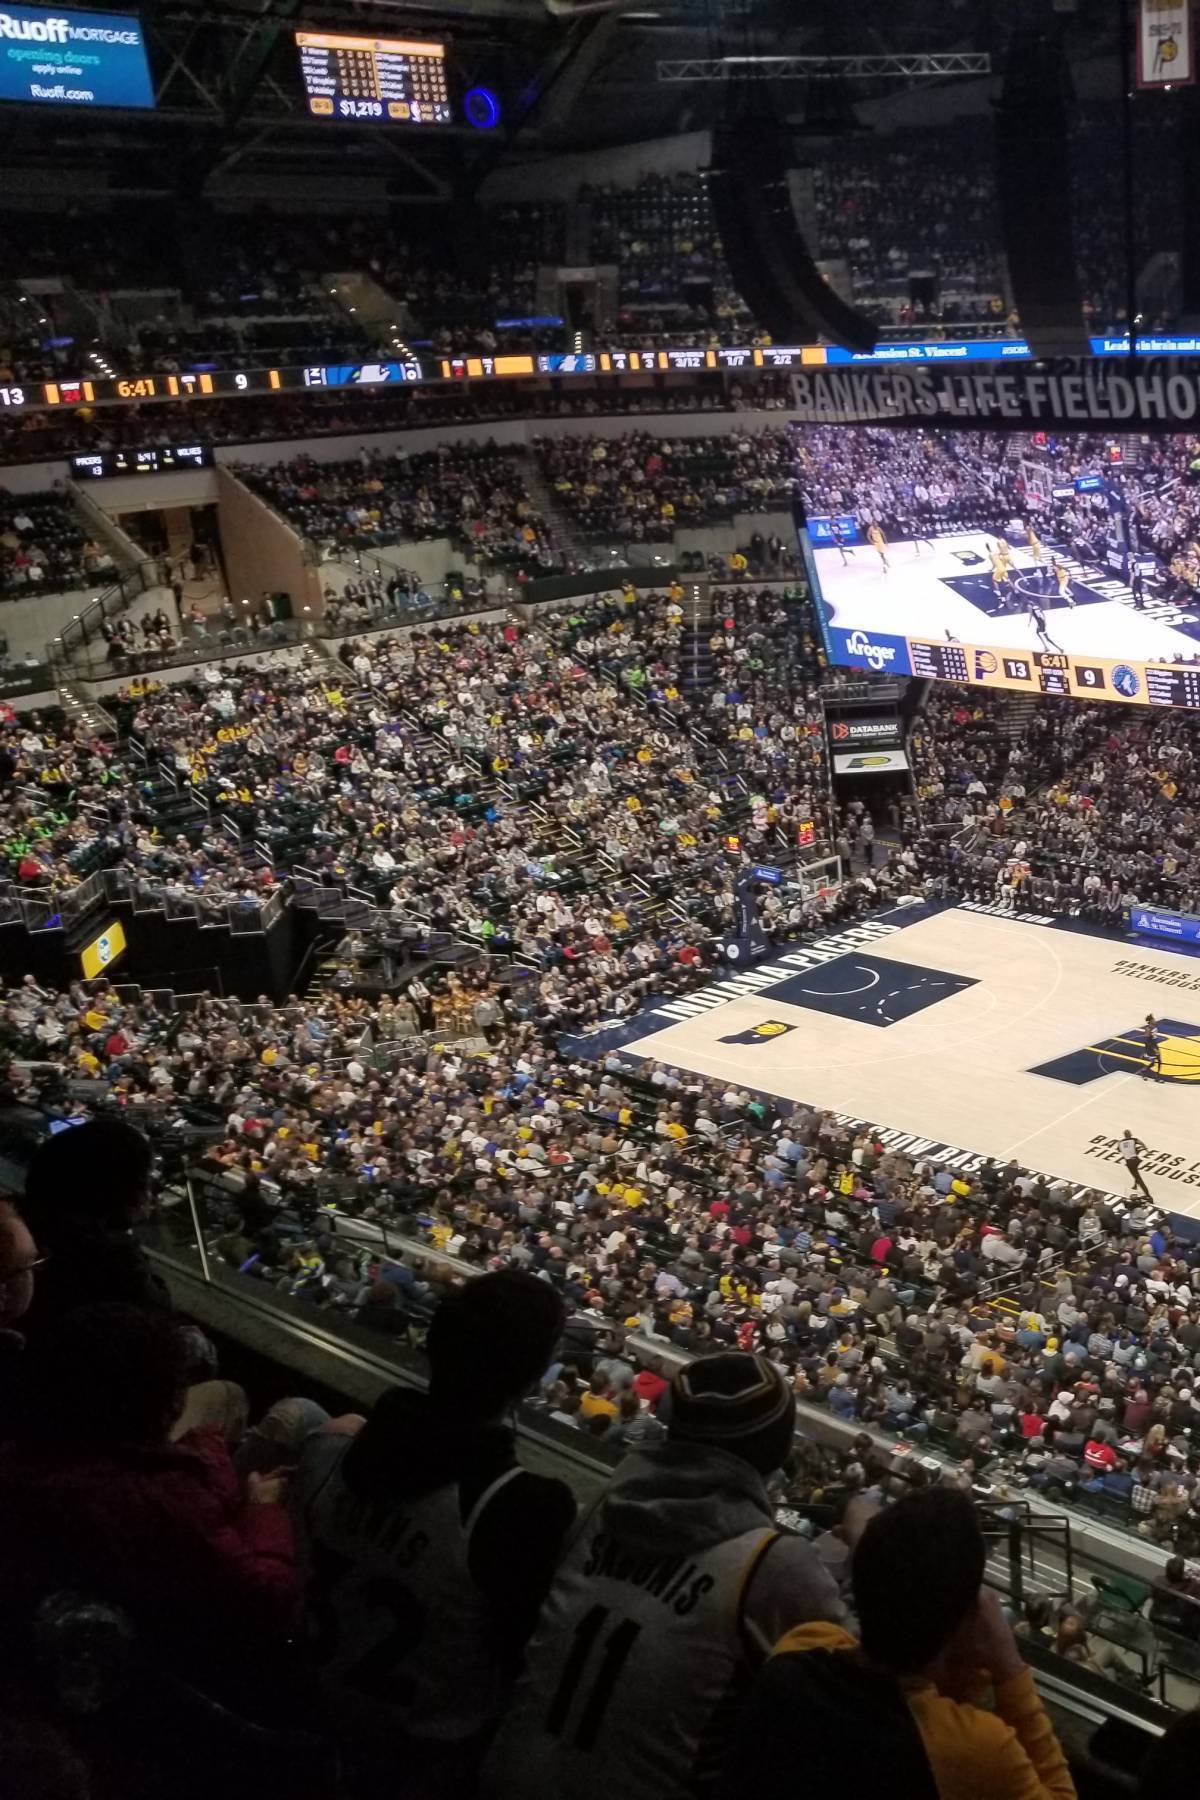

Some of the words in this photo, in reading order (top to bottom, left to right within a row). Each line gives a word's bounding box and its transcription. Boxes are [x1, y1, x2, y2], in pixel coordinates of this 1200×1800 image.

[0, 13, 69, 43] Ruoff
[70, 27, 140, 45] MORTGAGE
[30, 84, 94, 100] Ruoff.com
[339, 100, 382, 117] $1,219
[675, 358, 701, 369] 3/12
[117, 379, 156, 398] 6:41
[235, 374, 248, 390] 9
[0, 388, 25, 406] 13
[790, 373, 939, 416] BANKERS
[943, 376, 1022, 418] LIFE
[846, 630, 896, 670] Kroger
[1007, 661, 1027, 678] 13
[1041, 654, 1066, 669] 6:41
[1084, 670, 1095, 685] 9
[850, 724, 898, 734] DATABANK
[650, 964, 799, 1020] INDIANA
[778, 921, 902, 970] PACERS
[1115, 959, 1192, 981] BANKERS
[546, 1605, 642, 1752] 11
